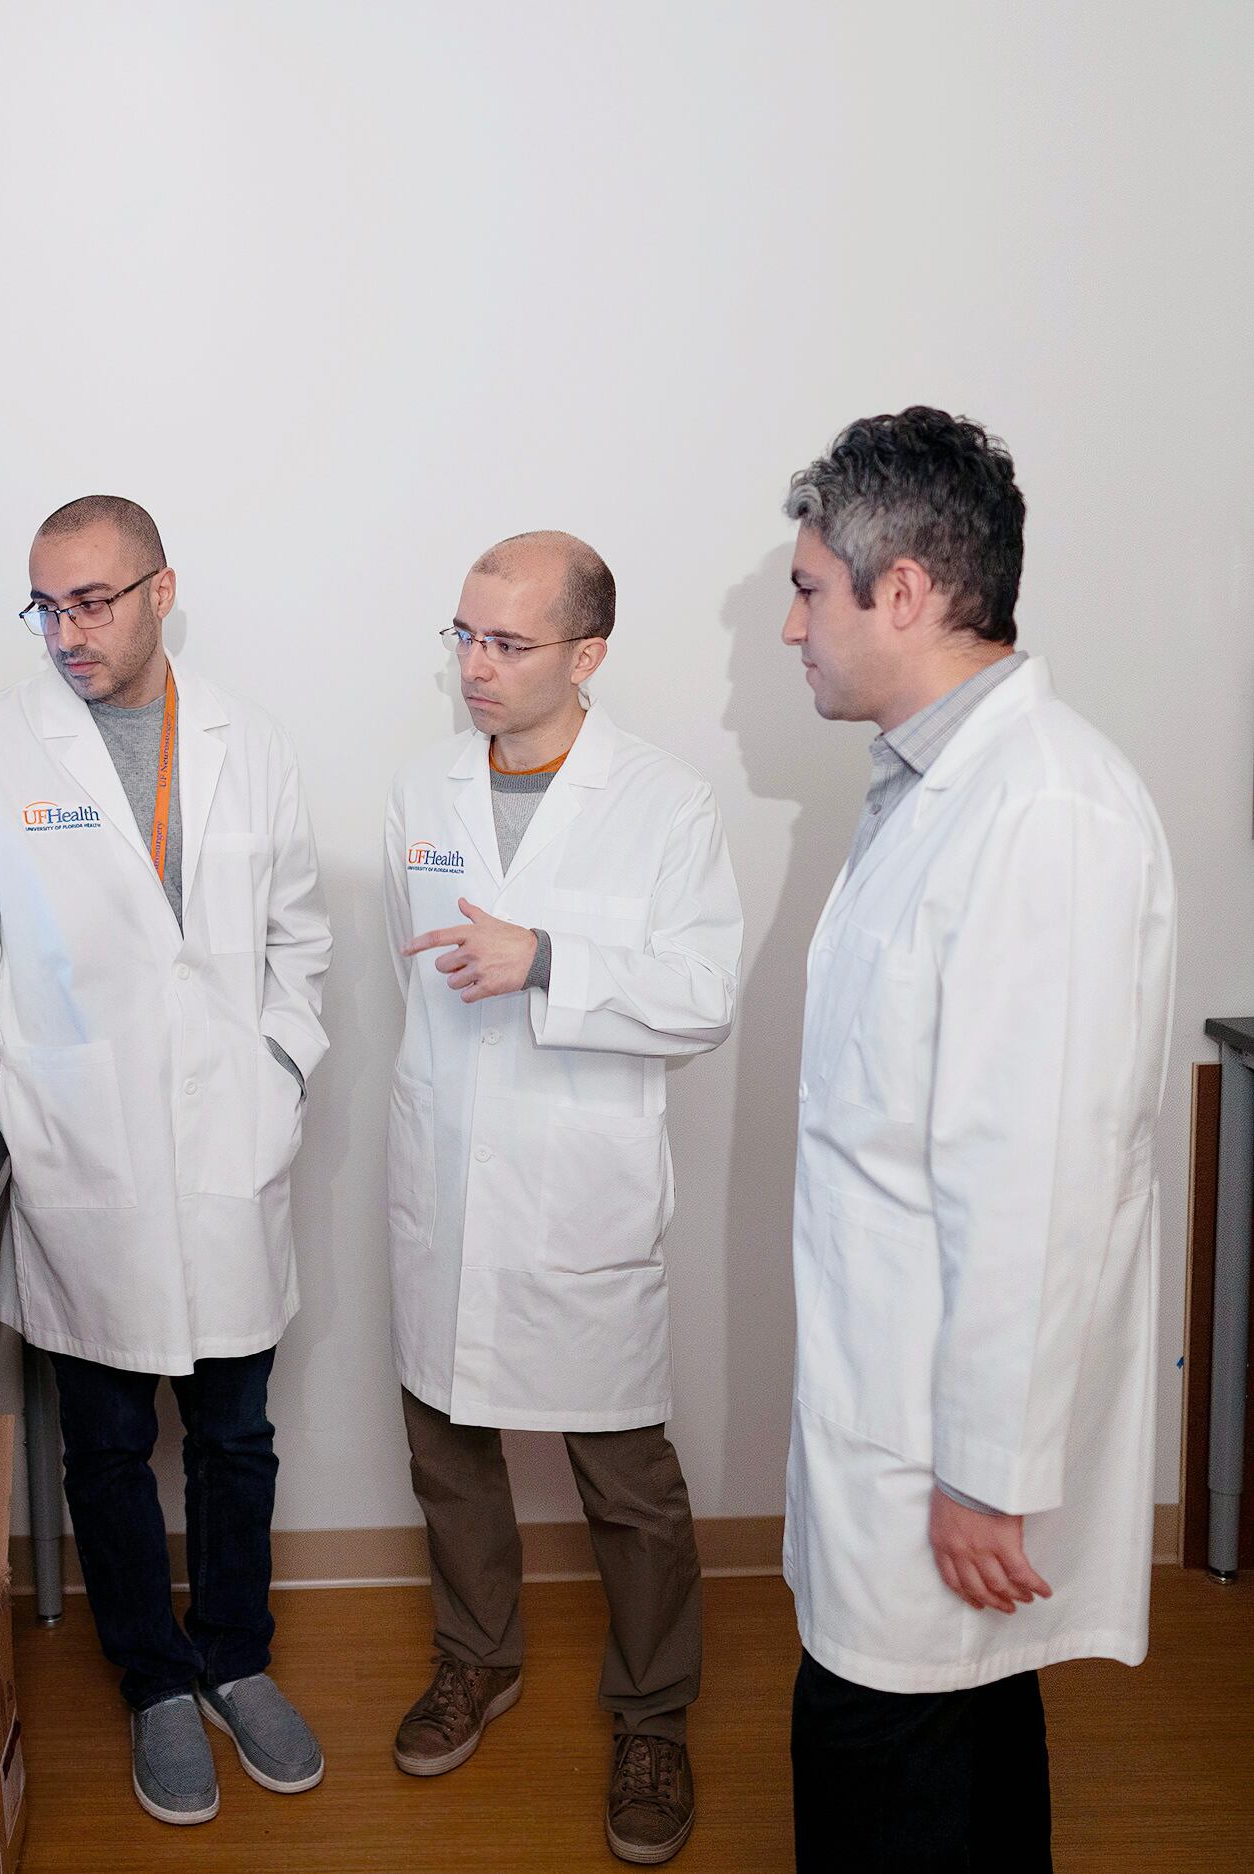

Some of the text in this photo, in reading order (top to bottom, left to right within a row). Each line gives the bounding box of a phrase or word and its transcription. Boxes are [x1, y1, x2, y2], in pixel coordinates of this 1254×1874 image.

[160, 713, 174, 787] UF Neurosurgery
[154, 822, 165, 870] urosurgery
